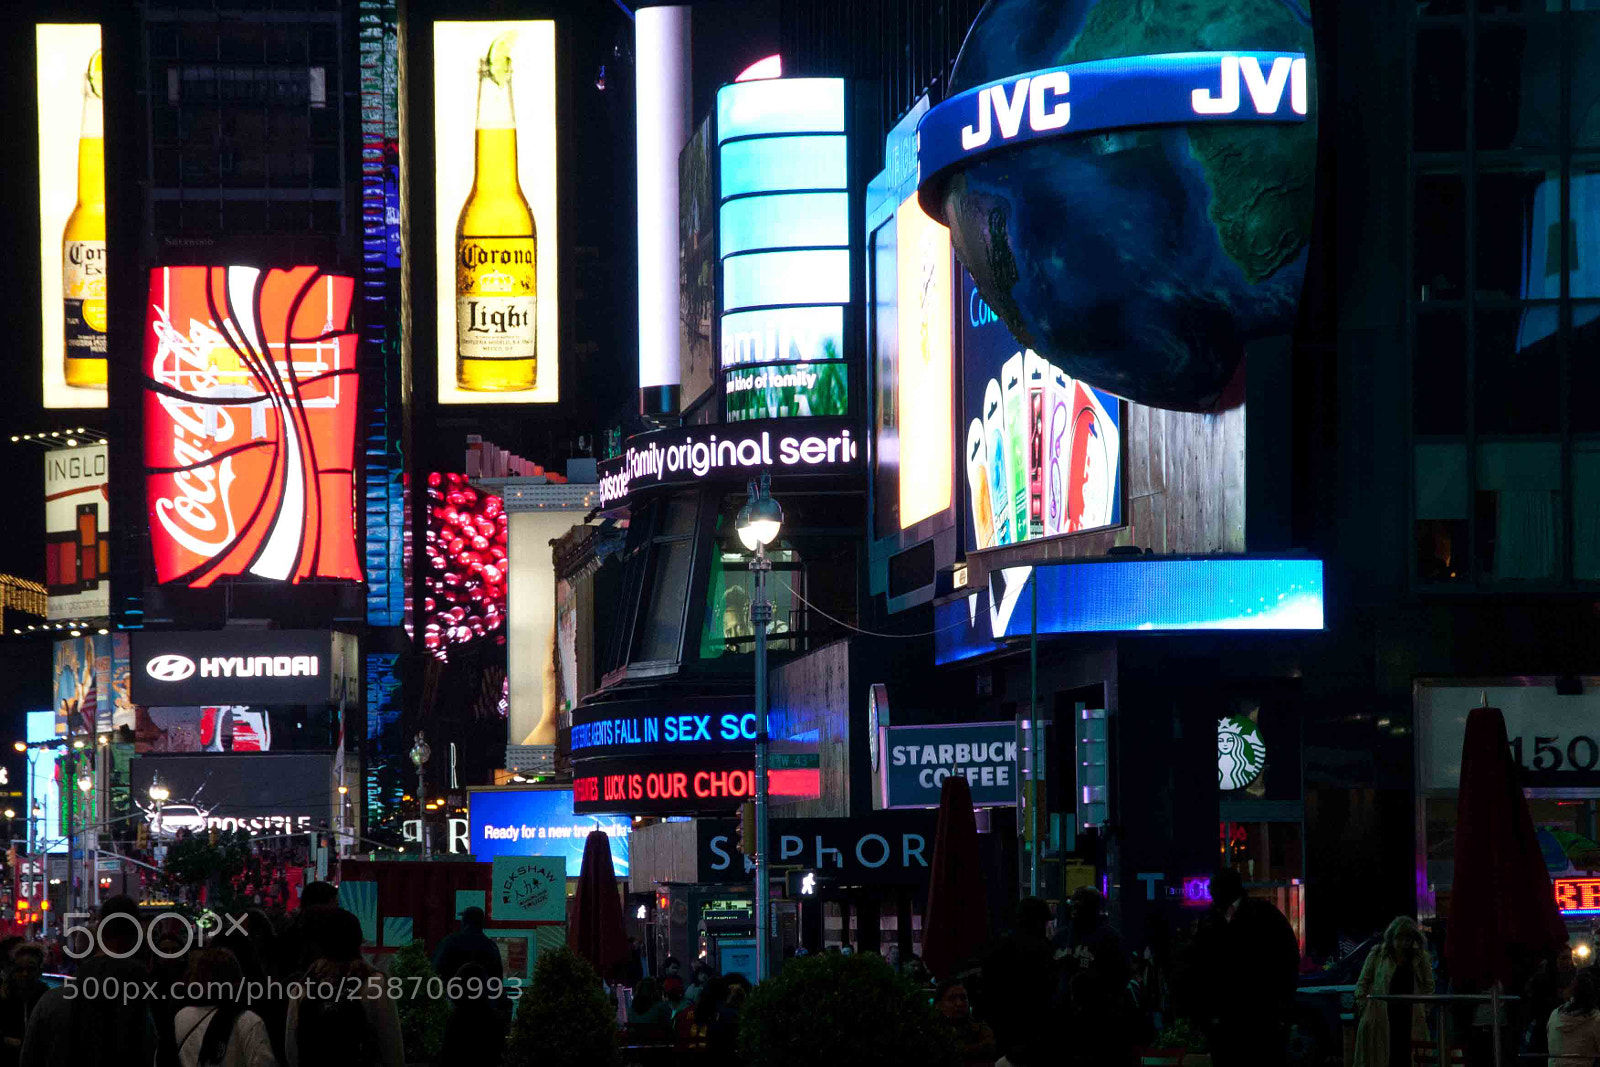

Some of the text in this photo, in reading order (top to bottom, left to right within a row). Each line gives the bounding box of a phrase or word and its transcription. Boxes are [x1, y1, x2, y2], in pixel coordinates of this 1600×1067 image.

[1191, 56, 1306, 115] JV
[961, 71, 1071, 150] JVC
[461, 243, 532, 272] Corona
[467, 301, 529, 334] Light
[735, 375, 753, 391] kind
[755, 372, 767, 389] of
[768, 371, 817, 389] family
[48, 455, 105, 481] INGLO
[631, 442, 665, 480] Family
[667, 432, 773, 476] original
[200, 656, 318, 677] HYUNDAI
[615, 718, 641, 744] FALL
[644, 717, 658, 742] IN
[664, 715, 711, 741] SEX
[720, 714, 769, 741] SC
[604, 774, 626, 800] LUCK
[628, 774, 643, 799] IS
[646, 772, 688, 799] OUR
[694, 770, 770, 797] CHOI
[919, 766, 1009, 789] COFEE
[484, 825, 519, 842] Ready
[521, 824, 536, 839] for
[538, 827, 546, 839] a
[548, 827, 571, 839] new
[709, 833, 929, 873] SPHOR
[503, 865, 557, 905] RICKSHAW
